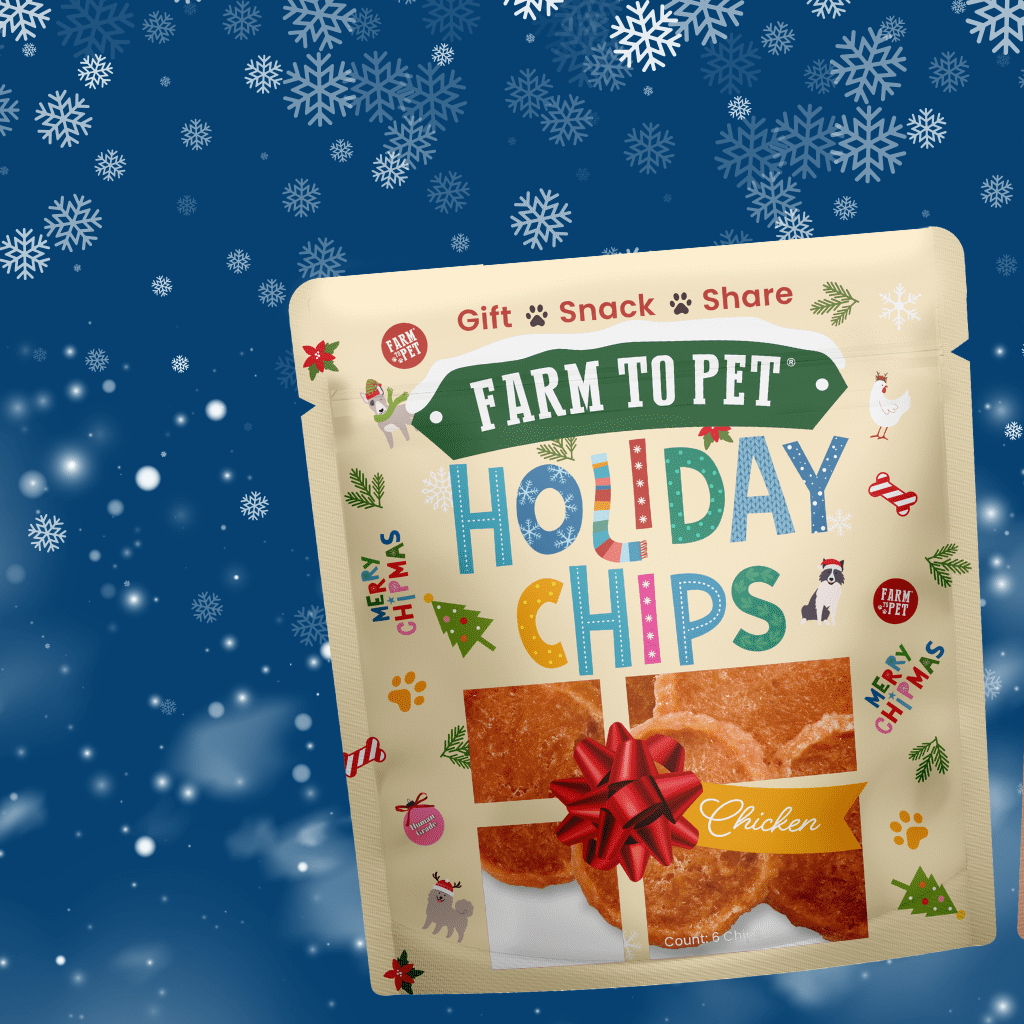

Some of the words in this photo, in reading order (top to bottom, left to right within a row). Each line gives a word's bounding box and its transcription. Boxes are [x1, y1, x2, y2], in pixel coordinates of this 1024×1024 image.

[458, 305, 513, 331] Gift
[559, 293, 656, 323] Snack
[702, 286, 793, 311] Share
[385, 328, 417, 353] FARM
[400, 341, 421, 361] PET
[470, 360, 604, 432] FARM
[617, 354, 676, 408] TO
[449, 436, 849, 574] HOLIDAY
[361, 556, 390, 622] MERRY
[881, 587, 911, 603] FARM
[888, 602, 909, 616] PET
[516, 564, 787, 675] CHIPS
[864, 643, 911, 709] MERRY
[700, 798, 821, 837] Chicken
[664, 931, 709, 947] Count:
[712, 931, 720, 942] 6
